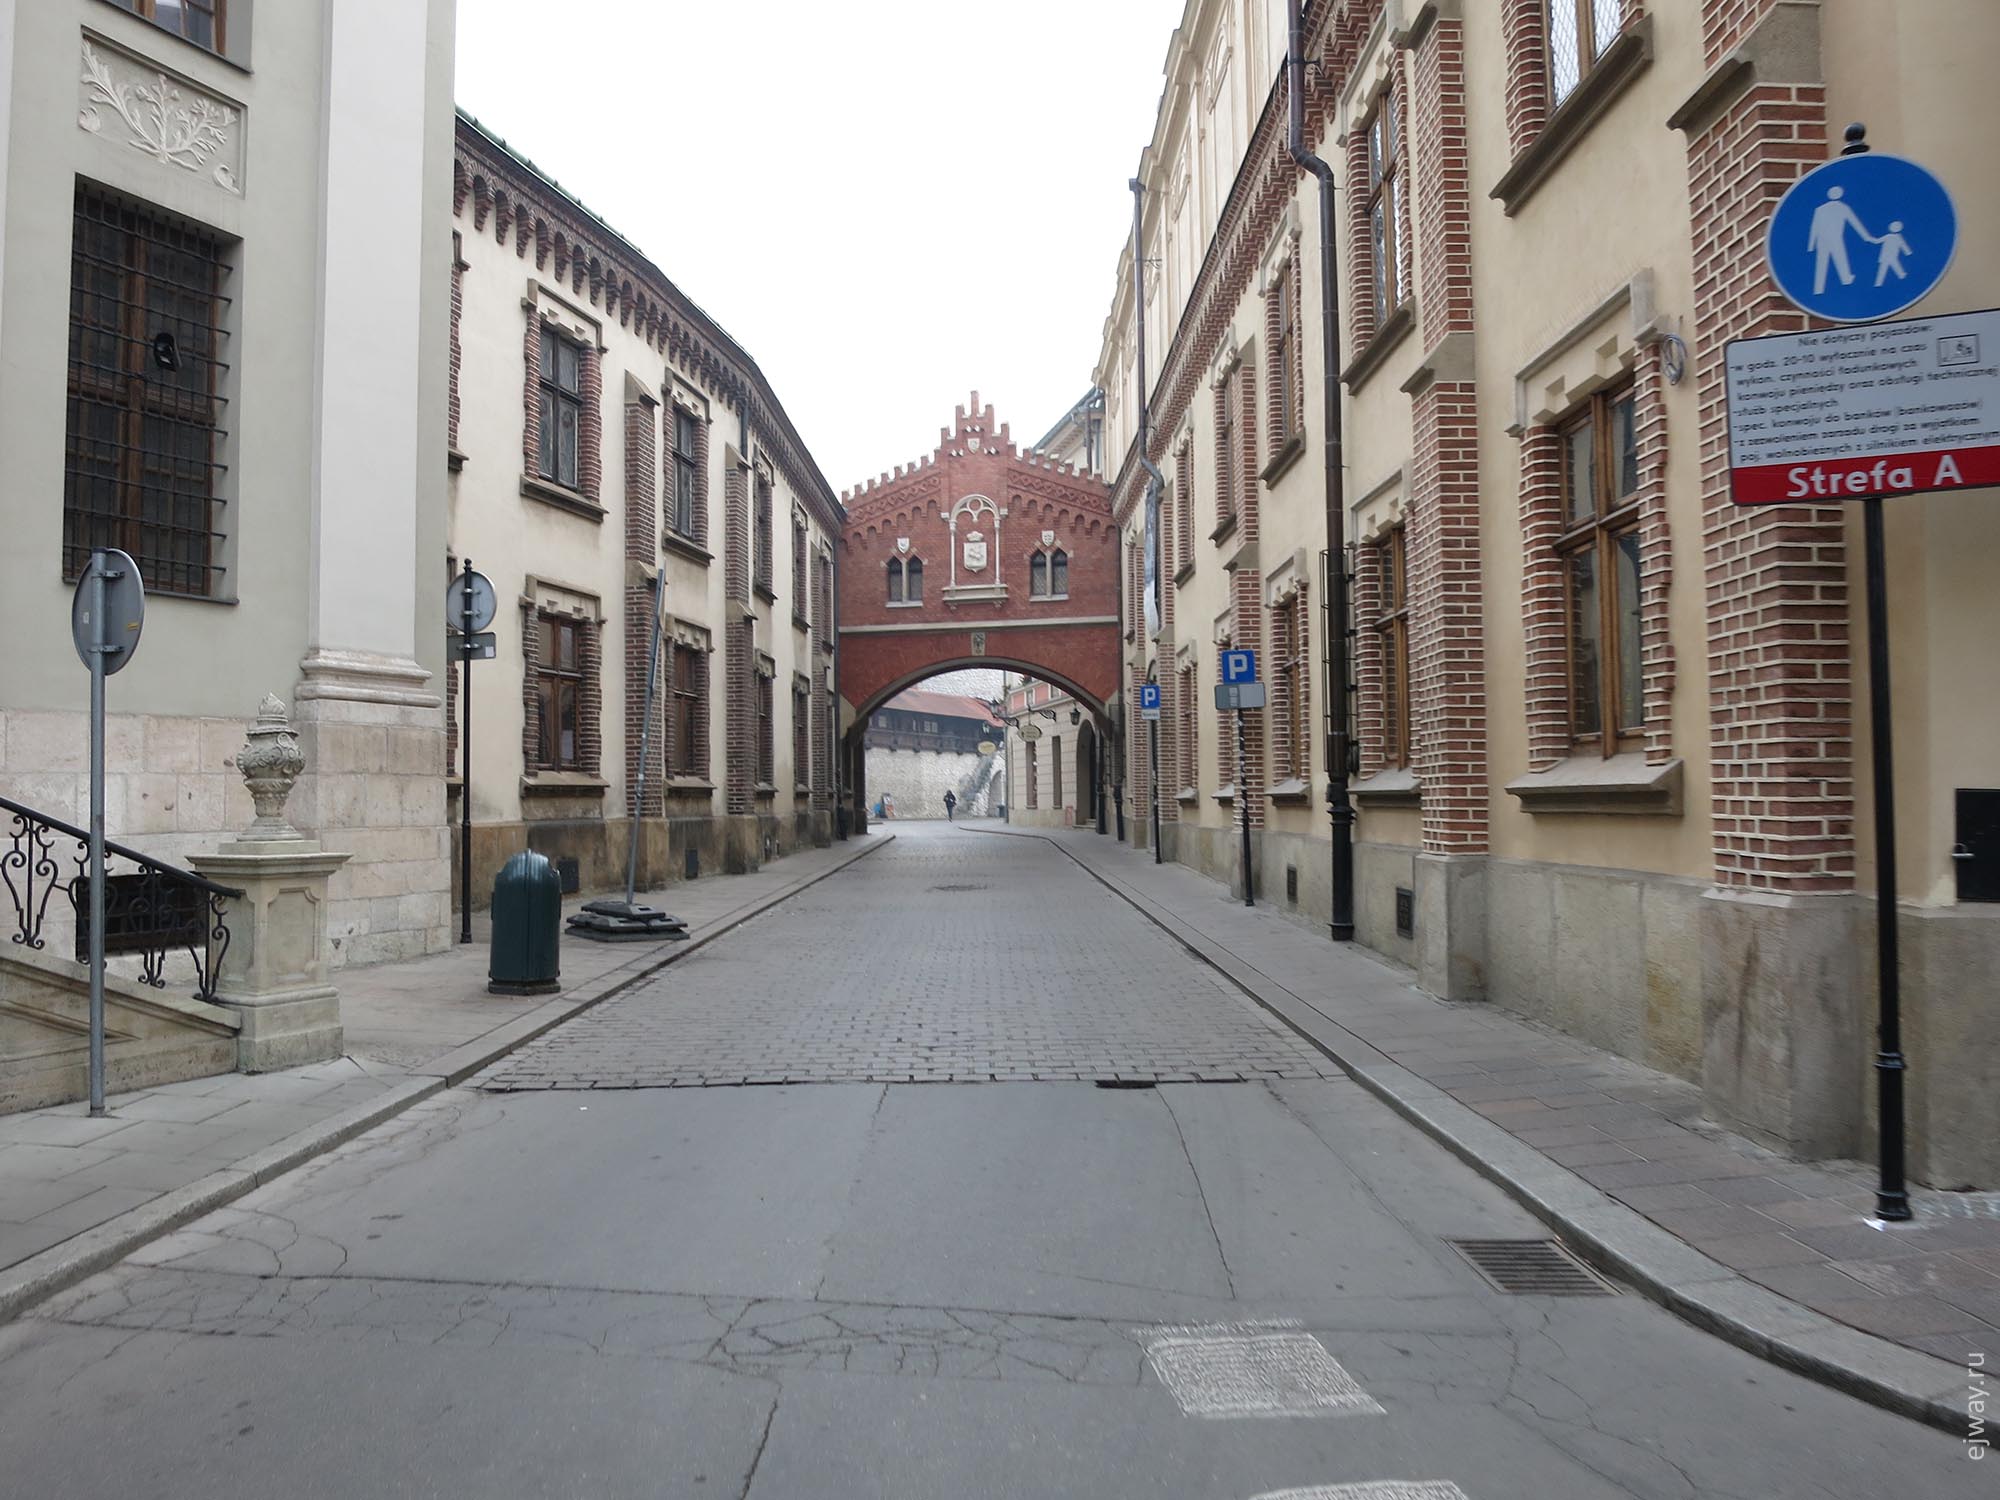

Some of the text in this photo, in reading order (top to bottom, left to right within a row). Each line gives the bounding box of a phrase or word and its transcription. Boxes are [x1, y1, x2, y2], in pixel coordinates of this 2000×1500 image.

[1798, 337, 1817, 346] Nie
[1823, 334, 1865, 344] dotyczy
[1747, 360, 1778, 373] godz.
[1783, 354, 1815, 366] 20-10
[1880, 346, 1897, 355] na
[1901, 343, 1928, 353] czas
[1737, 387, 1786, 401] konwoju
[1849, 379, 1875, 389] oraz
[1927, 364, 1999, 381] technicznej
[1770, 397, 1838, 415] specjalnych
[1772, 415, 1821, 428] konwoju
[1825, 412, 1840, 422] do
[1748, 431, 1818, 446] zezwoleniem
[1869, 422, 1898, 435] drogi
[1903, 422, 1917, 431] za
[1740, 450, 1761, 464] poj.
[1866, 438, 1917, 450] silnikiem
[1787, 455, 1963, 498] Strefa A
[1229, 653, 1248, 680] P
[1144, 687, 1157, 706] P
